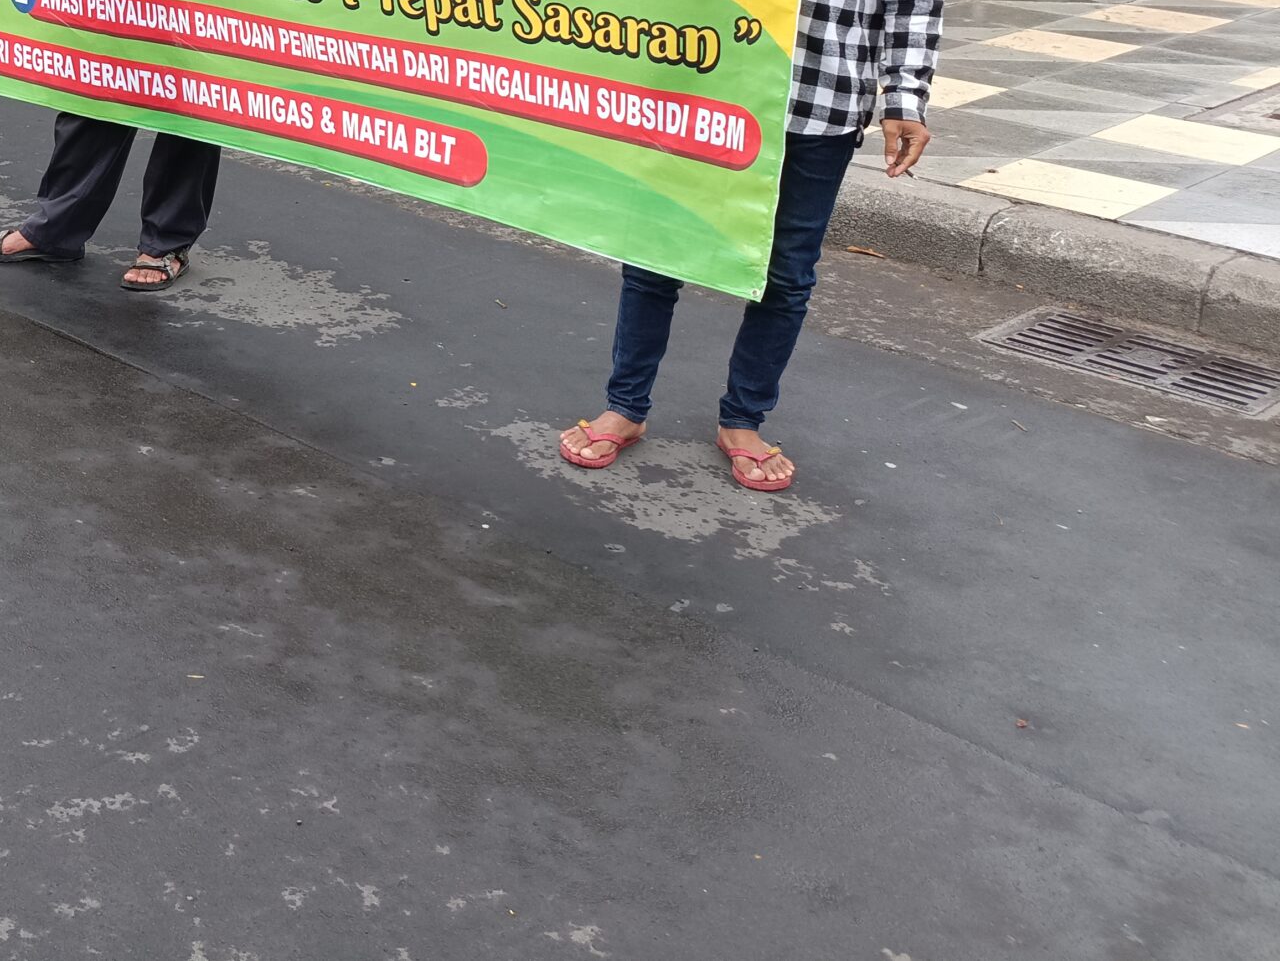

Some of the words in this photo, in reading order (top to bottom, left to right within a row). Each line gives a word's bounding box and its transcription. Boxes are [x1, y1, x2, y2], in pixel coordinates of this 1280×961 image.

[13, 43, 77, 82] SEGERA
[79, 58, 177, 101] BERANTAS
[181, 77, 243, 115] MAFIA
[247, 90, 314, 130] MIGAS
[320, 106, 337, 135] &
[342, 110, 409, 154] MAFIA
[414, 128, 456, 166] BLT
[194, 10, 275, 52] BANTUAN
[278, 28, 399, 74] PEMERINTAH
[403, 49, 450, 85] DARI
[455, 58, 590, 116] PENGALIHAN
[596, 87, 690, 138] SUBSIDI
[694, 108, 746, 152] BBM
